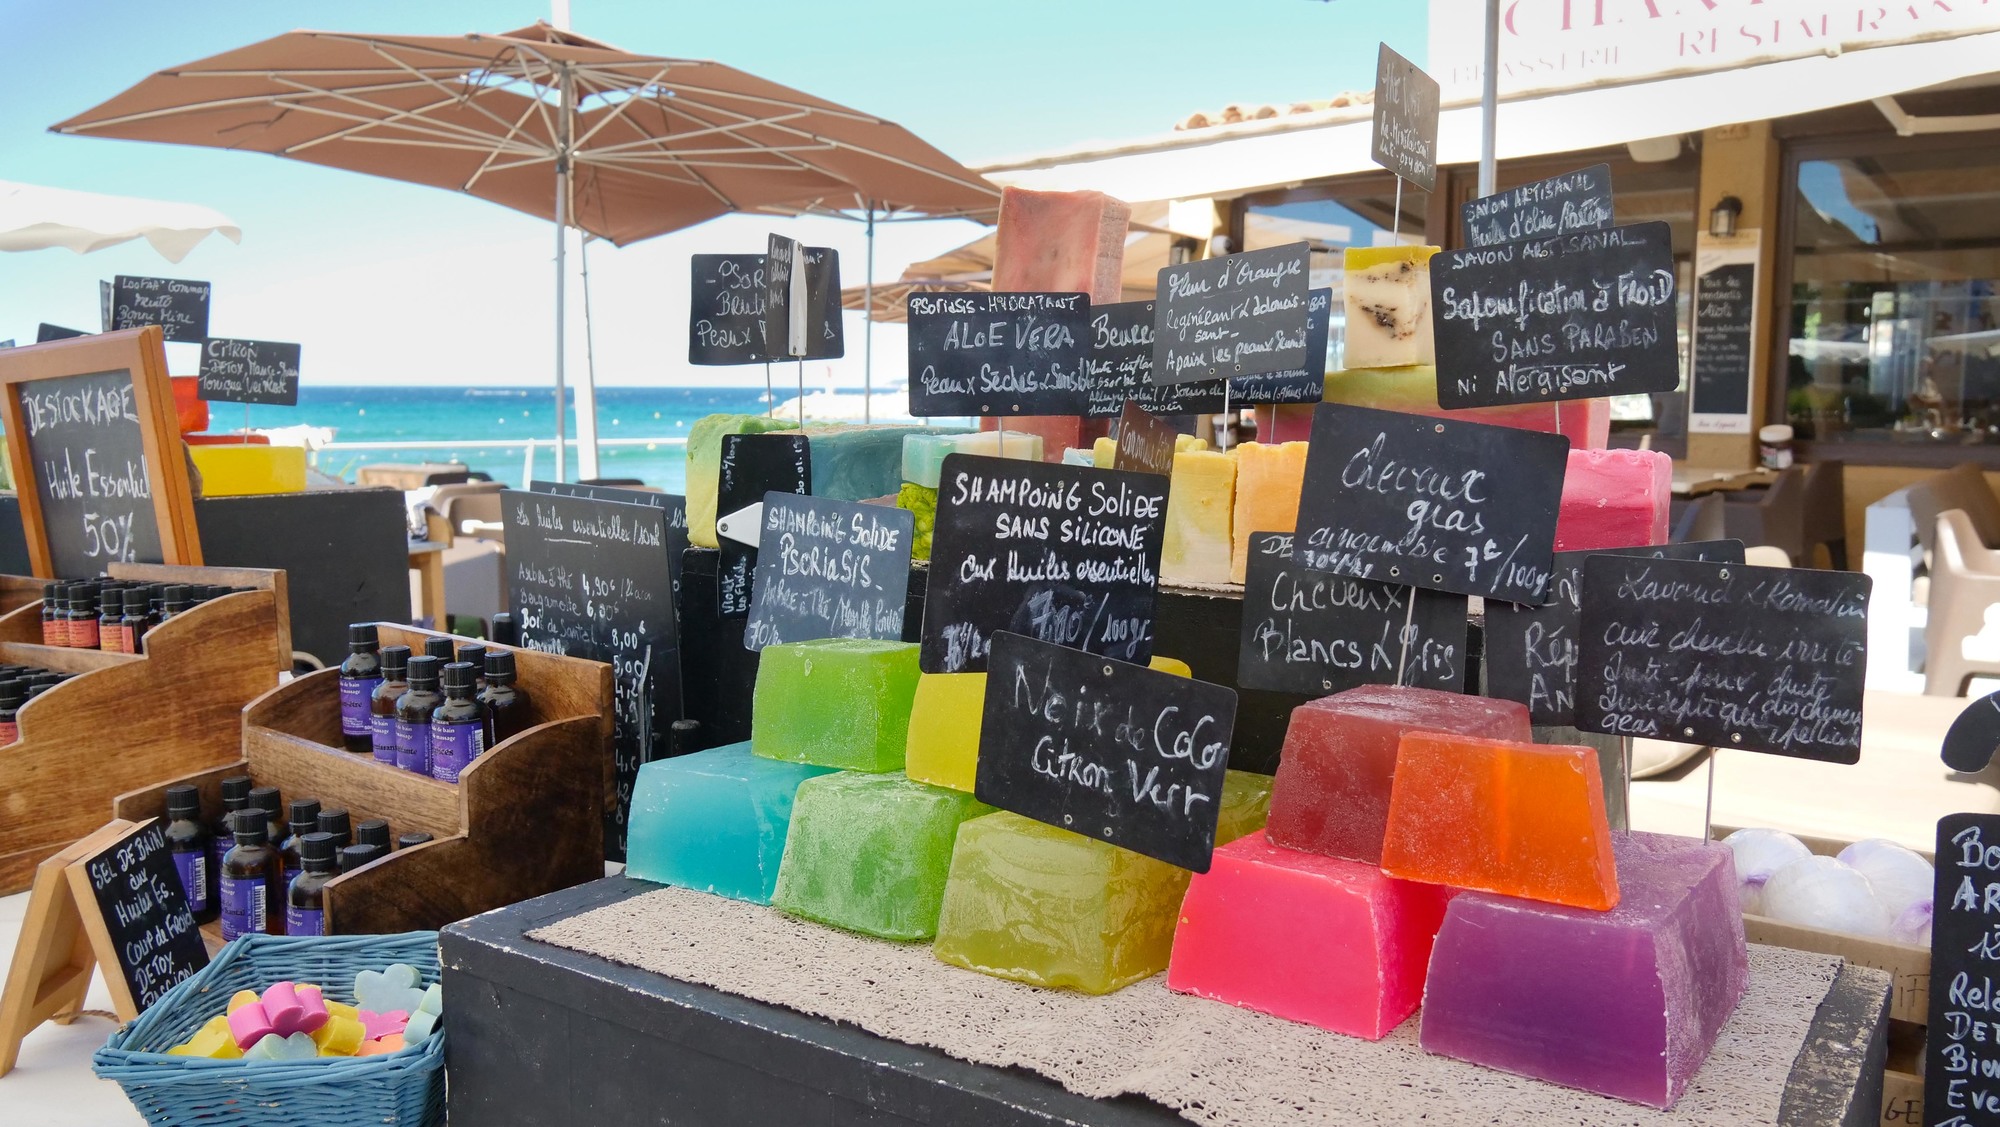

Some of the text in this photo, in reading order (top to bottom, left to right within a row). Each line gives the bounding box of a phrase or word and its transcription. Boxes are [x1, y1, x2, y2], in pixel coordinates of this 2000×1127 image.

[1452, 246, 1514, 270] SAVON
[1592, 278, 1613, 311] à
[696, 319, 751, 347] Peaux
[1492, 330, 1556, 363] SANS
[1562, 318, 1658, 353] PARABEN
[920, 364, 976, 396] Peaux
[1457, 375, 1477, 396] Ni
[83, 510, 136, 563] 50%
[995, 512, 1050, 539] SANS
[91, 861, 118, 890] SEL
[116, 842, 136, 873] DE
